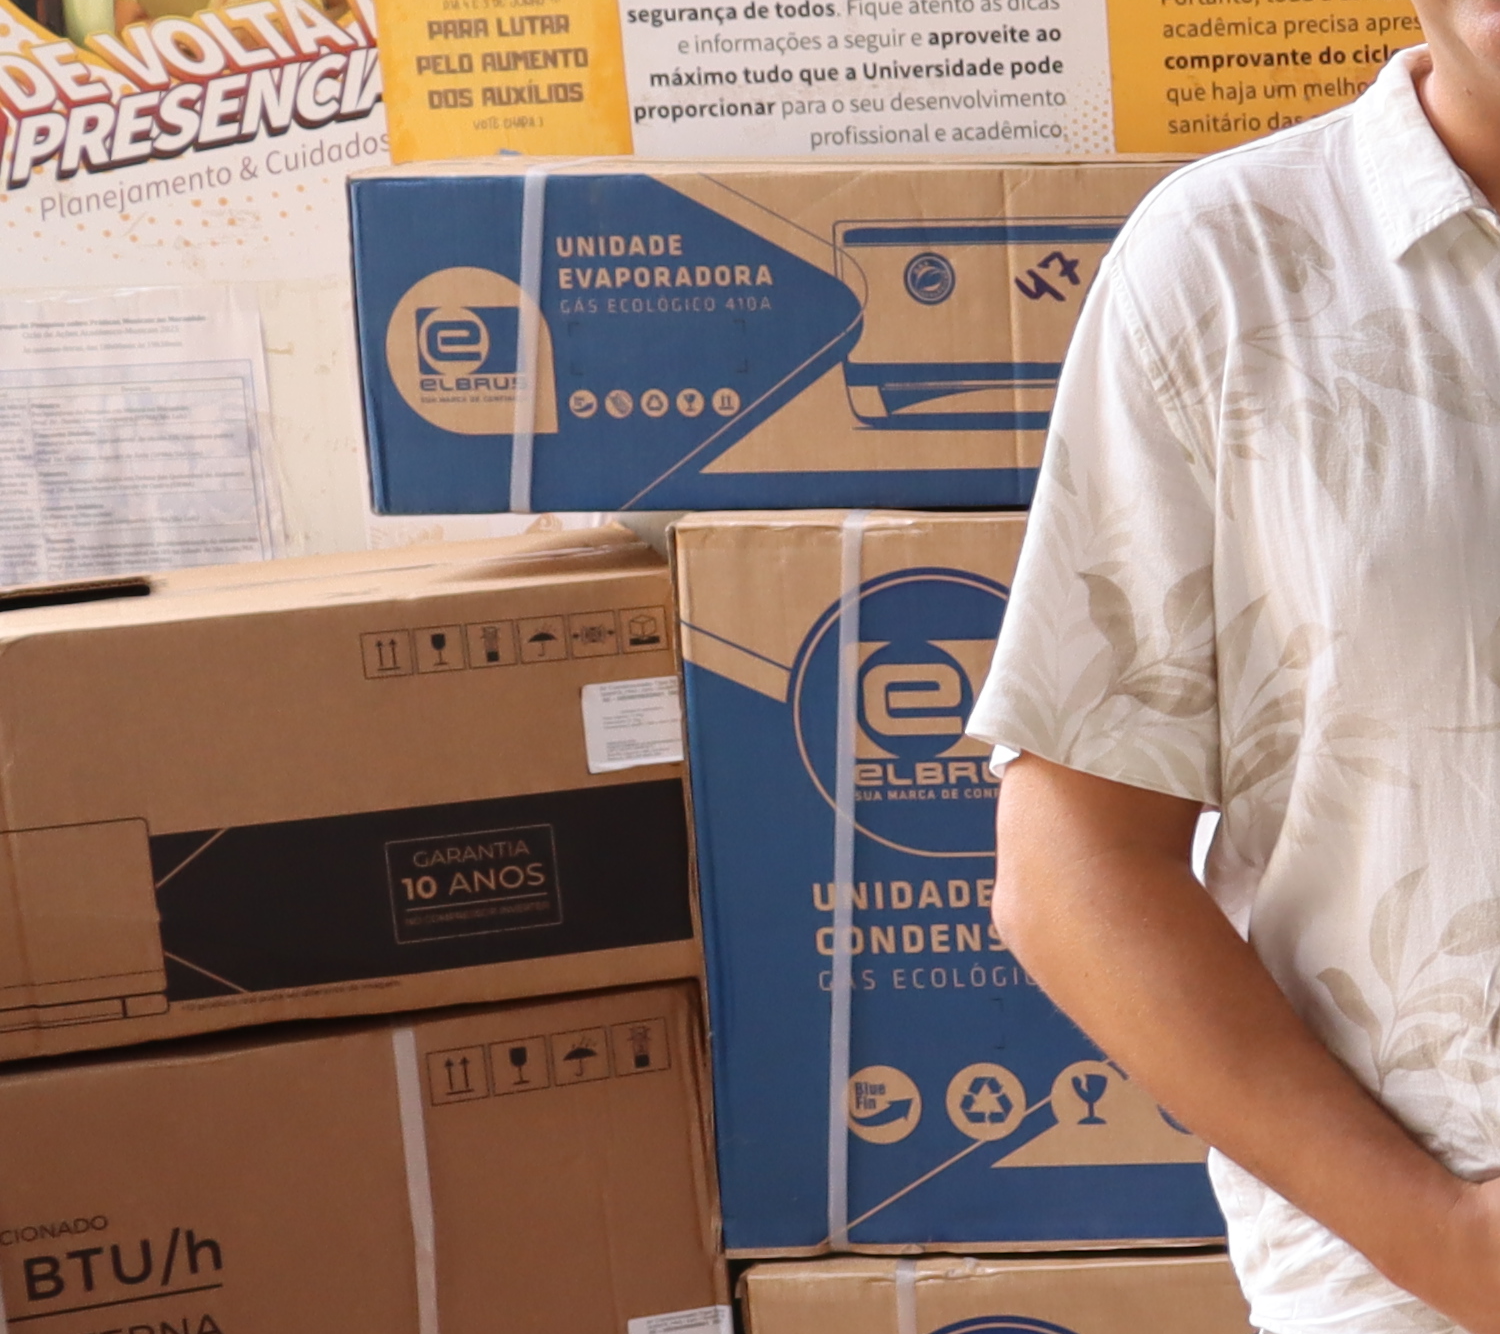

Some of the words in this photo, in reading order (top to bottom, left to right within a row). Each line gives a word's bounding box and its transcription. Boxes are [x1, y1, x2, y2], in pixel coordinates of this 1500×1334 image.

[428, 19, 488, 39] PARA
[497, 15, 570, 37] LUTAR
[416, 53, 472, 75] PELO
[482, 48, 588, 72] AUMENTO
[650, 66, 738, 87] máximo
[744, 66, 793, 84] tudo
[799, 68, 839, 88] que
[846, 69, 857, 81] a
[863, 59, 1003, 80] Universidade
[1011, 56, 1063, 78] pode
[428, 88, 472, 109] DOS
[482, 79, 584, 106] AUXÍLIOS
[39, 165, 231, 220] Planejamento
[240, 157, 258, 180] &
[265, 133, 390, 174] Cuidados
[556, 235, 683, 257] UNIDADE
[558, 264, 773, 289] EVAPORADORA
[1015, 252, 1080, 301] 47
[560, 295, 598, 314] GÁS
[608, 295, 715, 313] ECOLÓGICO
[724, 296, 771, 311] 410A
[413, 840, 529, 867] GARANTIA
[402, 876, 437, 901] 10
[449, 863, 546, 895] ANOS
[23, 1227, 222, 1301] BTU/h
